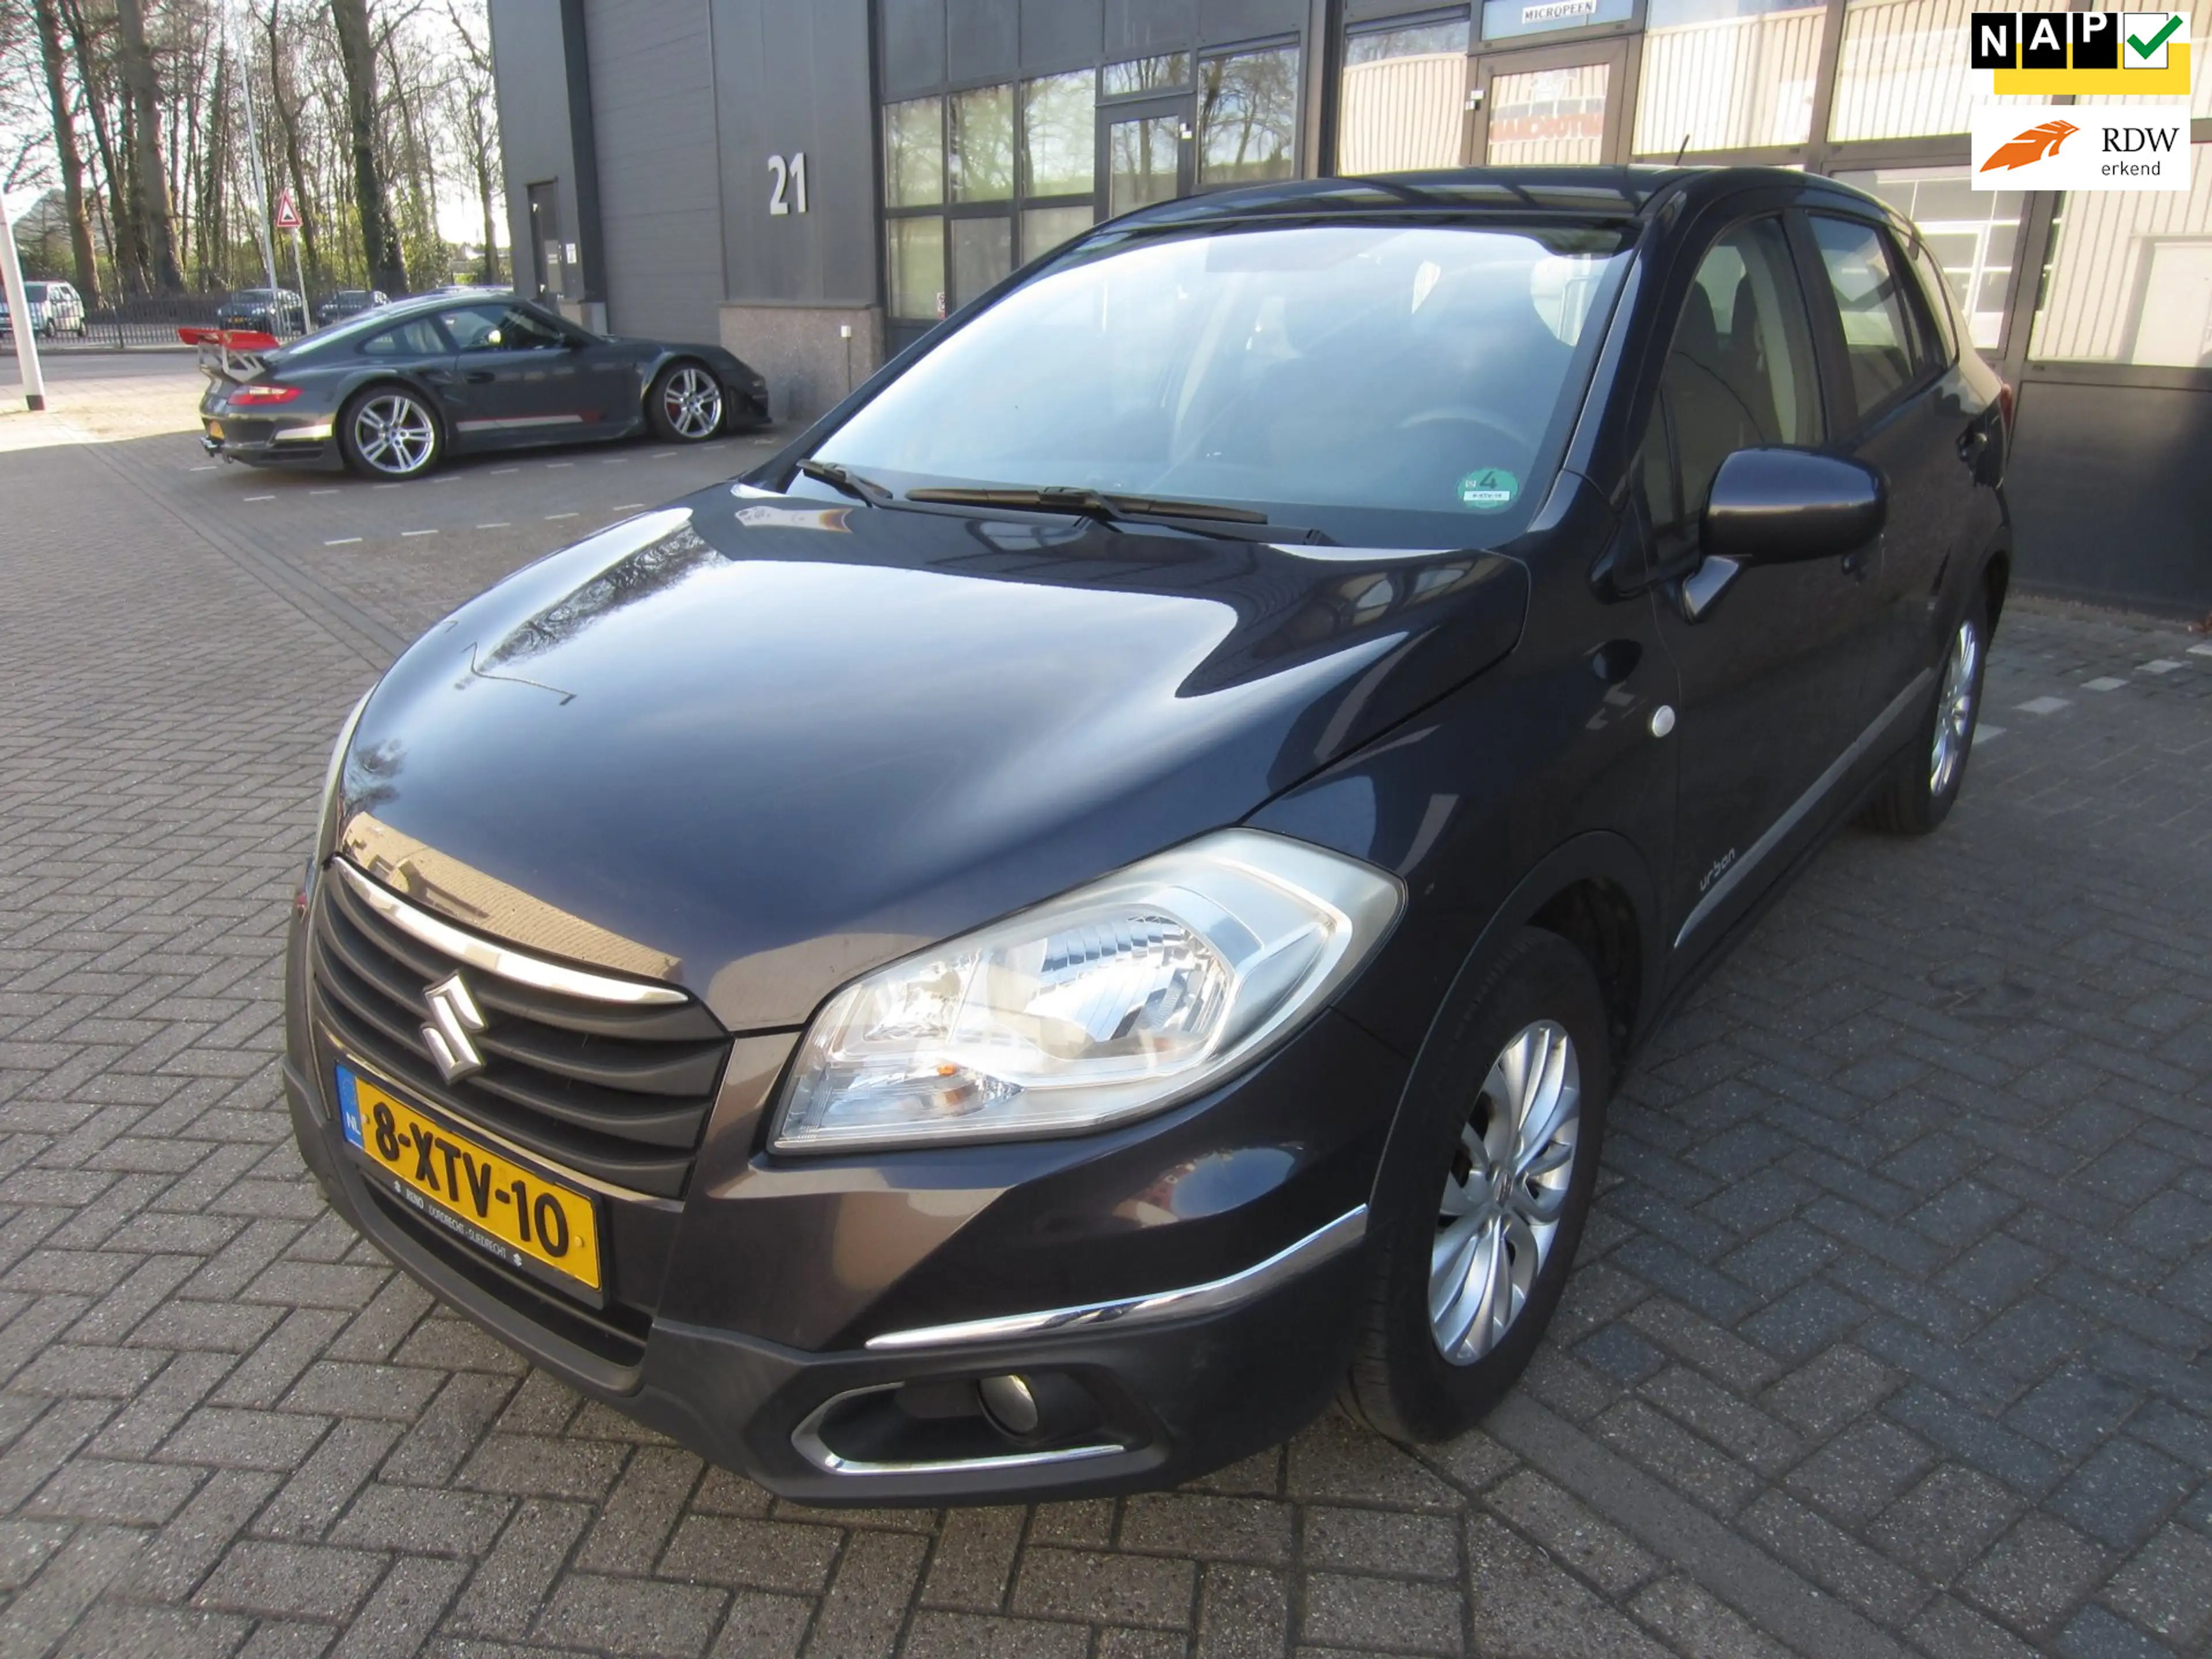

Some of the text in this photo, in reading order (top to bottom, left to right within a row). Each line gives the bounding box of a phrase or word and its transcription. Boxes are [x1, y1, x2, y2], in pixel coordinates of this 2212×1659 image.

[768, 153, 806, 214] 21
[1479, 471, 1497, 490] 4
[1700, 847, 1735, 892] urban
[346, 1112, 361, 1135] NL
[373, 1101, 569, 1257] 8-XTV-10
